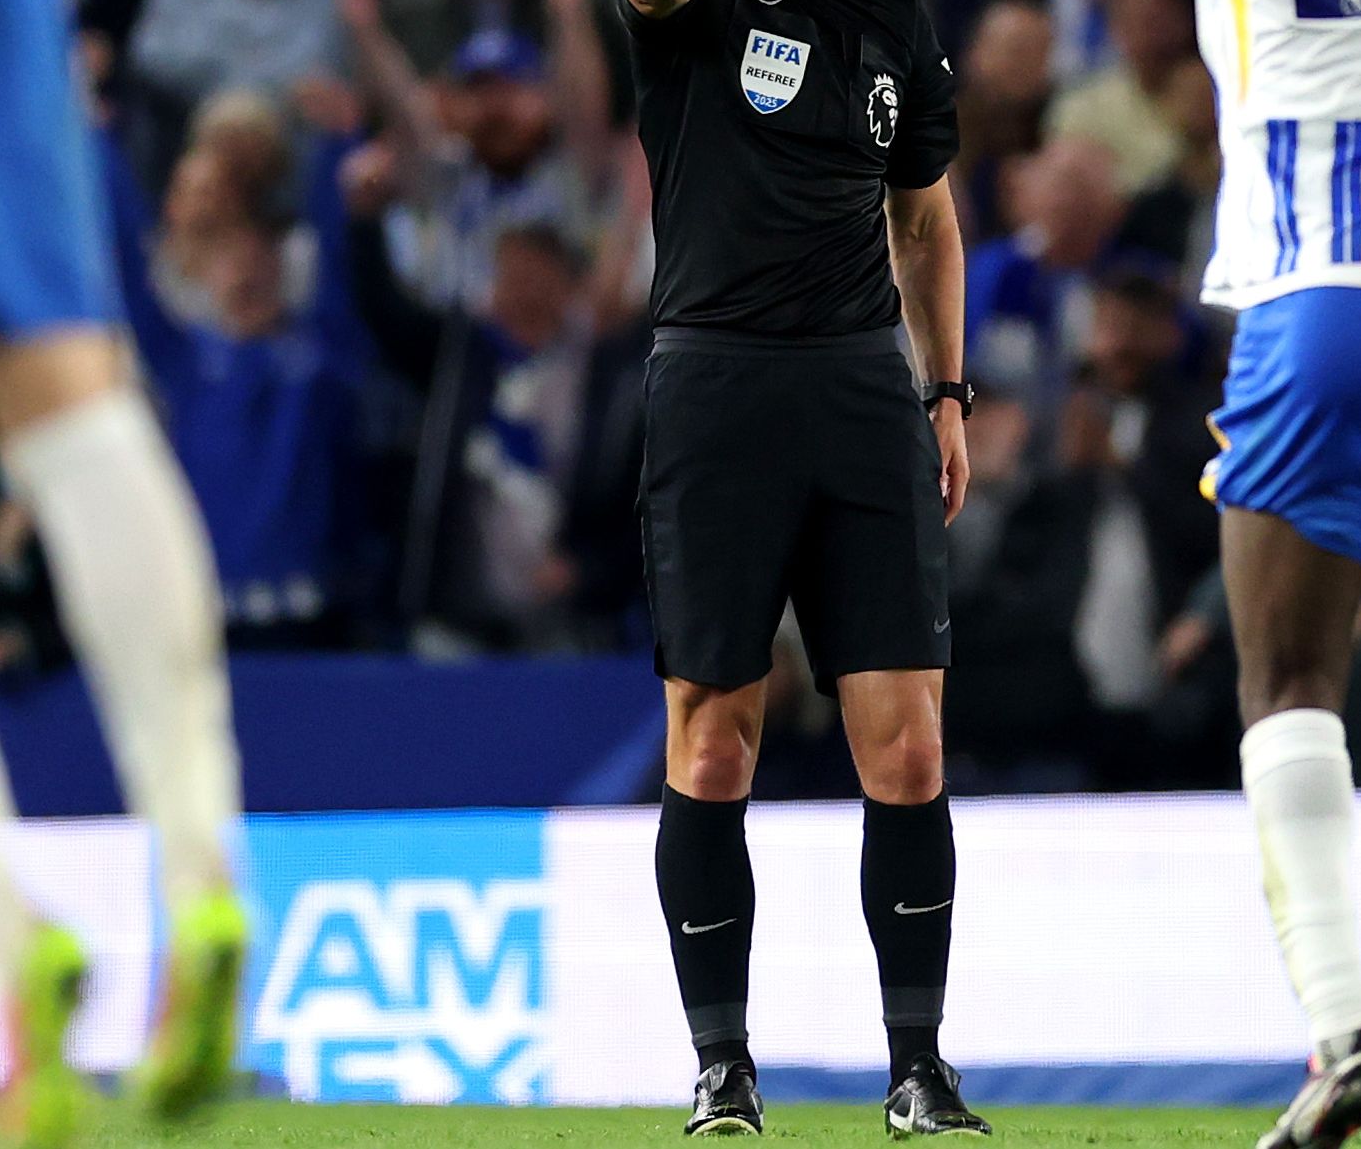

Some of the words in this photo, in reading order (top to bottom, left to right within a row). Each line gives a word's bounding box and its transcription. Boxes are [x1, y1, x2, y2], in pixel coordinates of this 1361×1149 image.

[751, 36, 801, 65] FIFA
[745, 66, 796, 87] REFEREE
[753, 94, 778, 108] 2025
[254, 878, 544, 1026] AM
